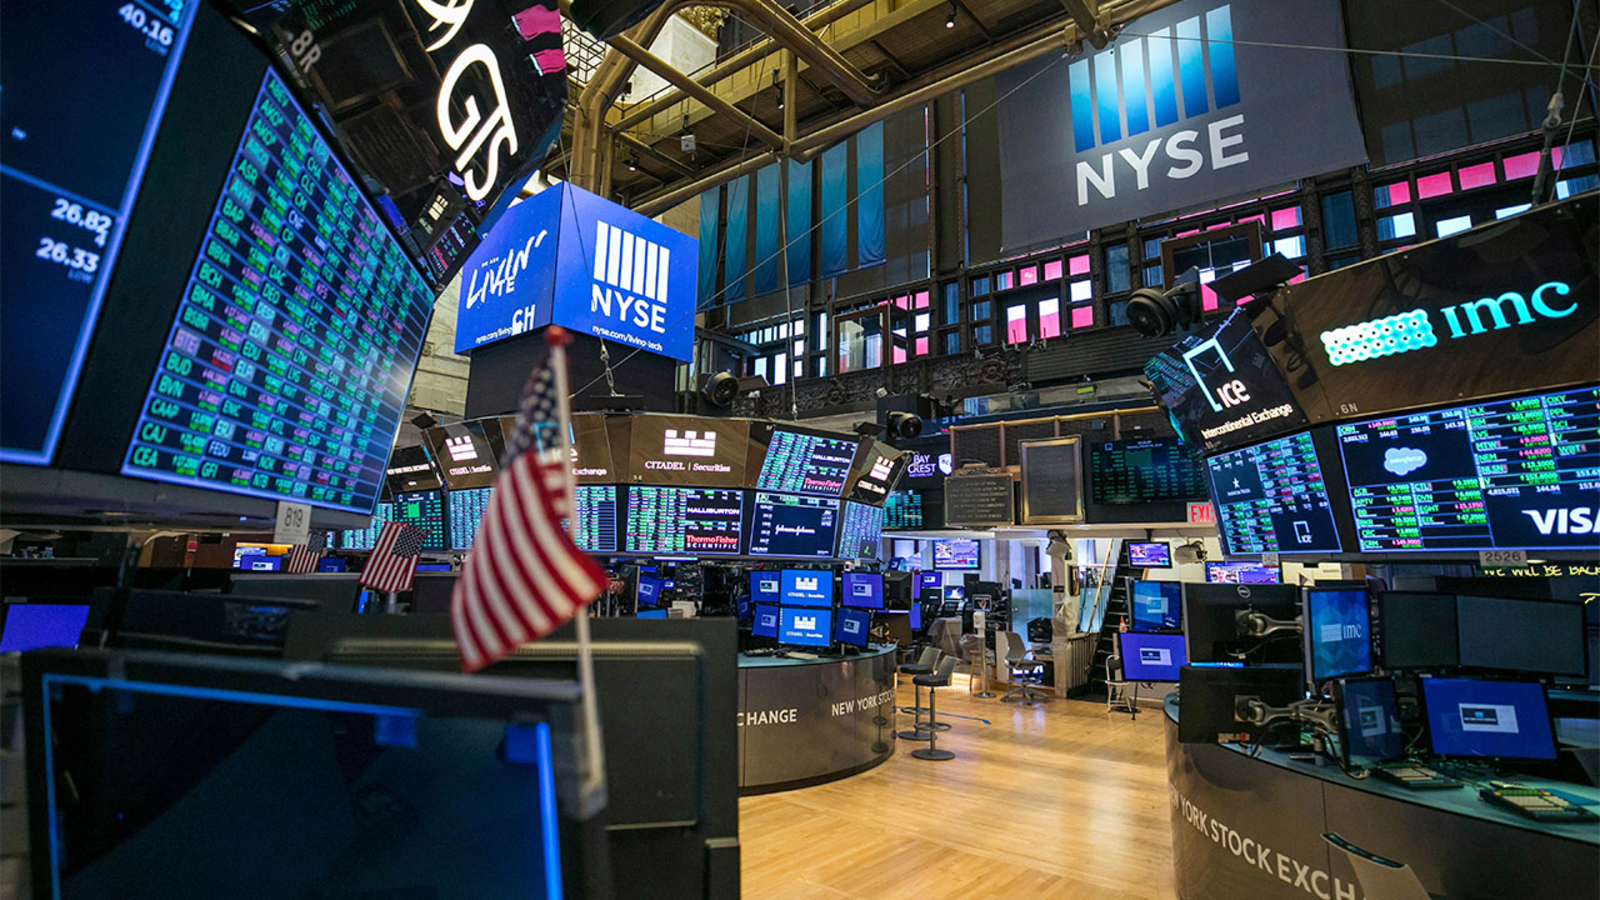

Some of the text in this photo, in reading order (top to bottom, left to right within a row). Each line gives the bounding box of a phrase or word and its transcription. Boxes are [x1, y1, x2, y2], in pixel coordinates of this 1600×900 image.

[118, 3, 174, 46] 40.16
[308, 157, 321, 180] CHA
[1076, 114, 1249, 206] NYSE
[238, 160, 258, 184] ASR
[302, 174, 314, 195] CLS
[51, 199, 111, 231] 26.82
[223, 198, 244, 222] BAP
[282, 228, 294, 242] CP
[36, 238, 100, 272] 26.33
[200, 263, 222, 288] BCH
[269, 264, 286, 286] DAC
[192, 285, 214, 310] BMA
[262, 283, 280, 304] DEO
[591, 283, 666, 334] NYSE
[1440, 281, 1578, 339] imc
[243, 340, 261, 360] EDU
[167, 352, 191, 375] BUD
[159, 375, 184, 397] BVN
[152, 399, 179, 418] CAAP
[1547, 395, 1566, 404] OXY
[1201, 403, 1294, 439] Intercontinental Exchange
[142, 423, 166, 442] CAJ
[134, 447, 157, 466] CEA
[210, 441, 229, 456] FEDU
[1479, 453, 1497, 462] NEM
[1558, 444, 1581, 453] WBT
[645, 460, 731, 472] CITADEL Securities
[907, 463, 936, 474] CREST
[913, 454, 930, 465] BAY
[284, 507, 303, 528] 819
[687, 507, 740, 515] HALLIBURTON
[1191, 504, 1214, 522] EXI
[1522, 507, 1600, 535] VIS
[1484, 551, 1521, 561] 2526
[1543, 565, 1562, 576] BE
[1343, 623, 1361, 639] imc
[831, 700, 855, 717] NEW
[856, 695, 878, 711] YORK
[1180, 794, 1209, 837] YORK
[1211, 818, 1273, 875] STOCK
[1276, 852, 1366, 900] EXCH
